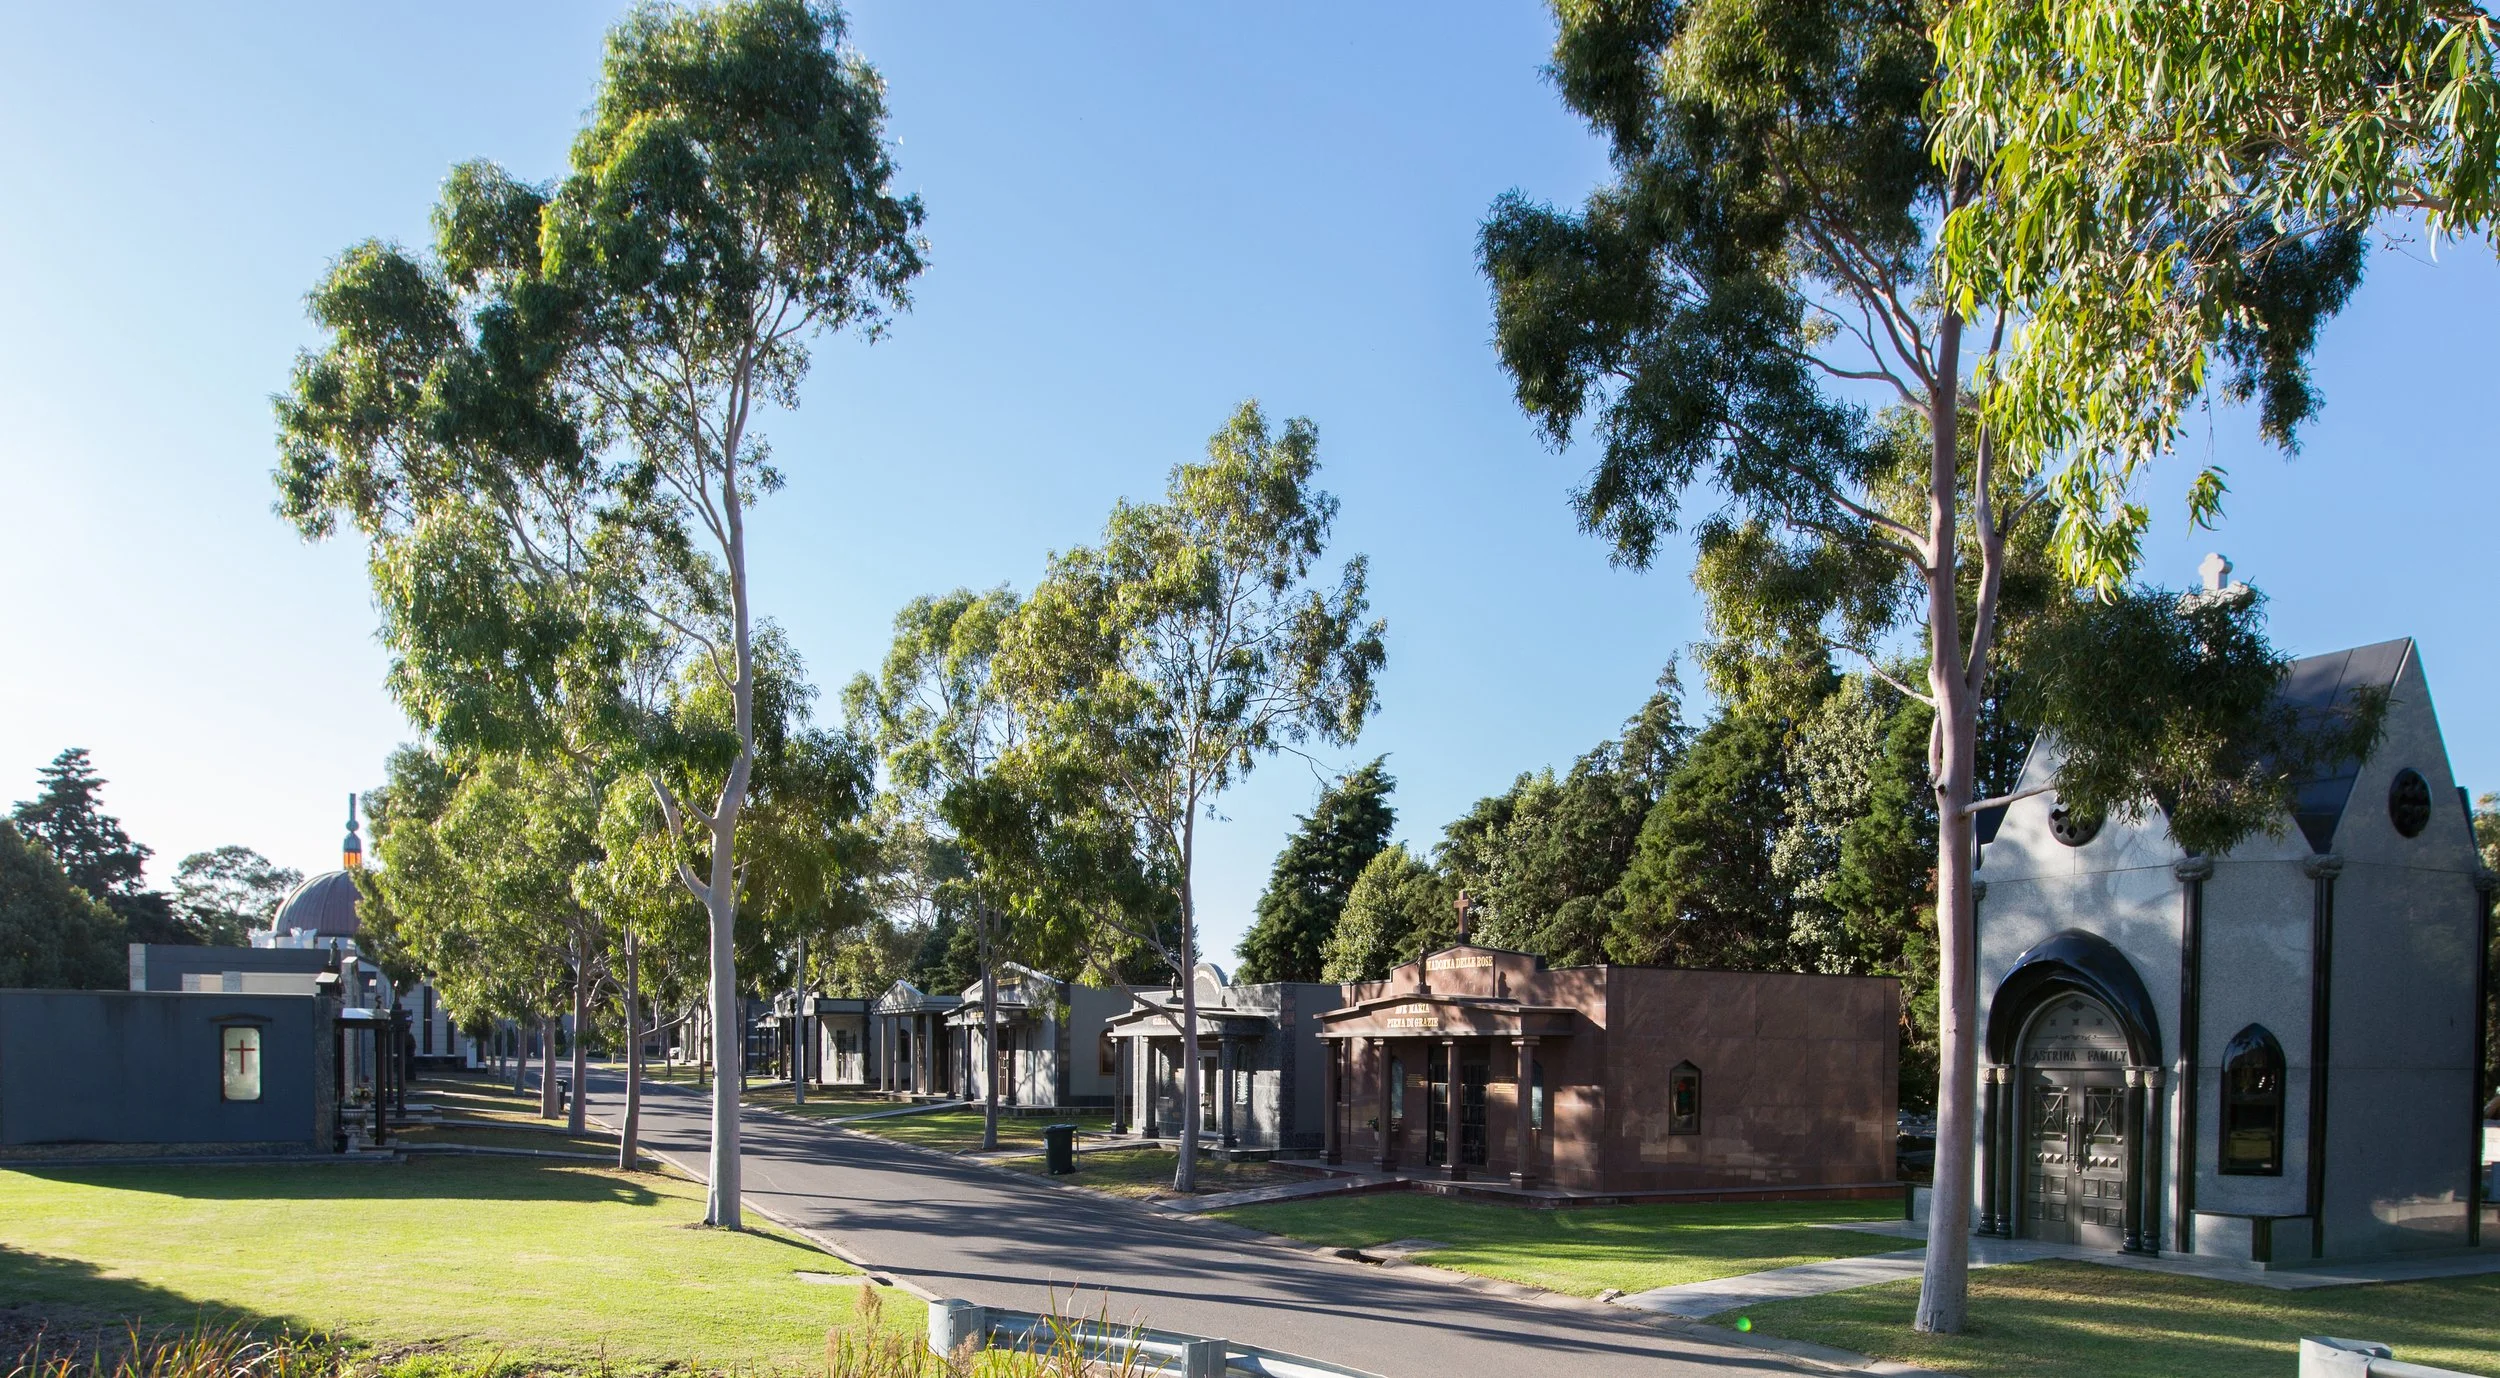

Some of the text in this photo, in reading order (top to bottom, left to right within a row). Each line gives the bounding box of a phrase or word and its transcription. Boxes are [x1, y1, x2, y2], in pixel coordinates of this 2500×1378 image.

[1426, 955, 1493, 971] MADONNA DELLE ROSE
[1409, 1003, 1430, 1013] MARIA
[1406, 1017, 1414, 1027] DI
[2087, 1050, 2127, 1062] FAMILY
